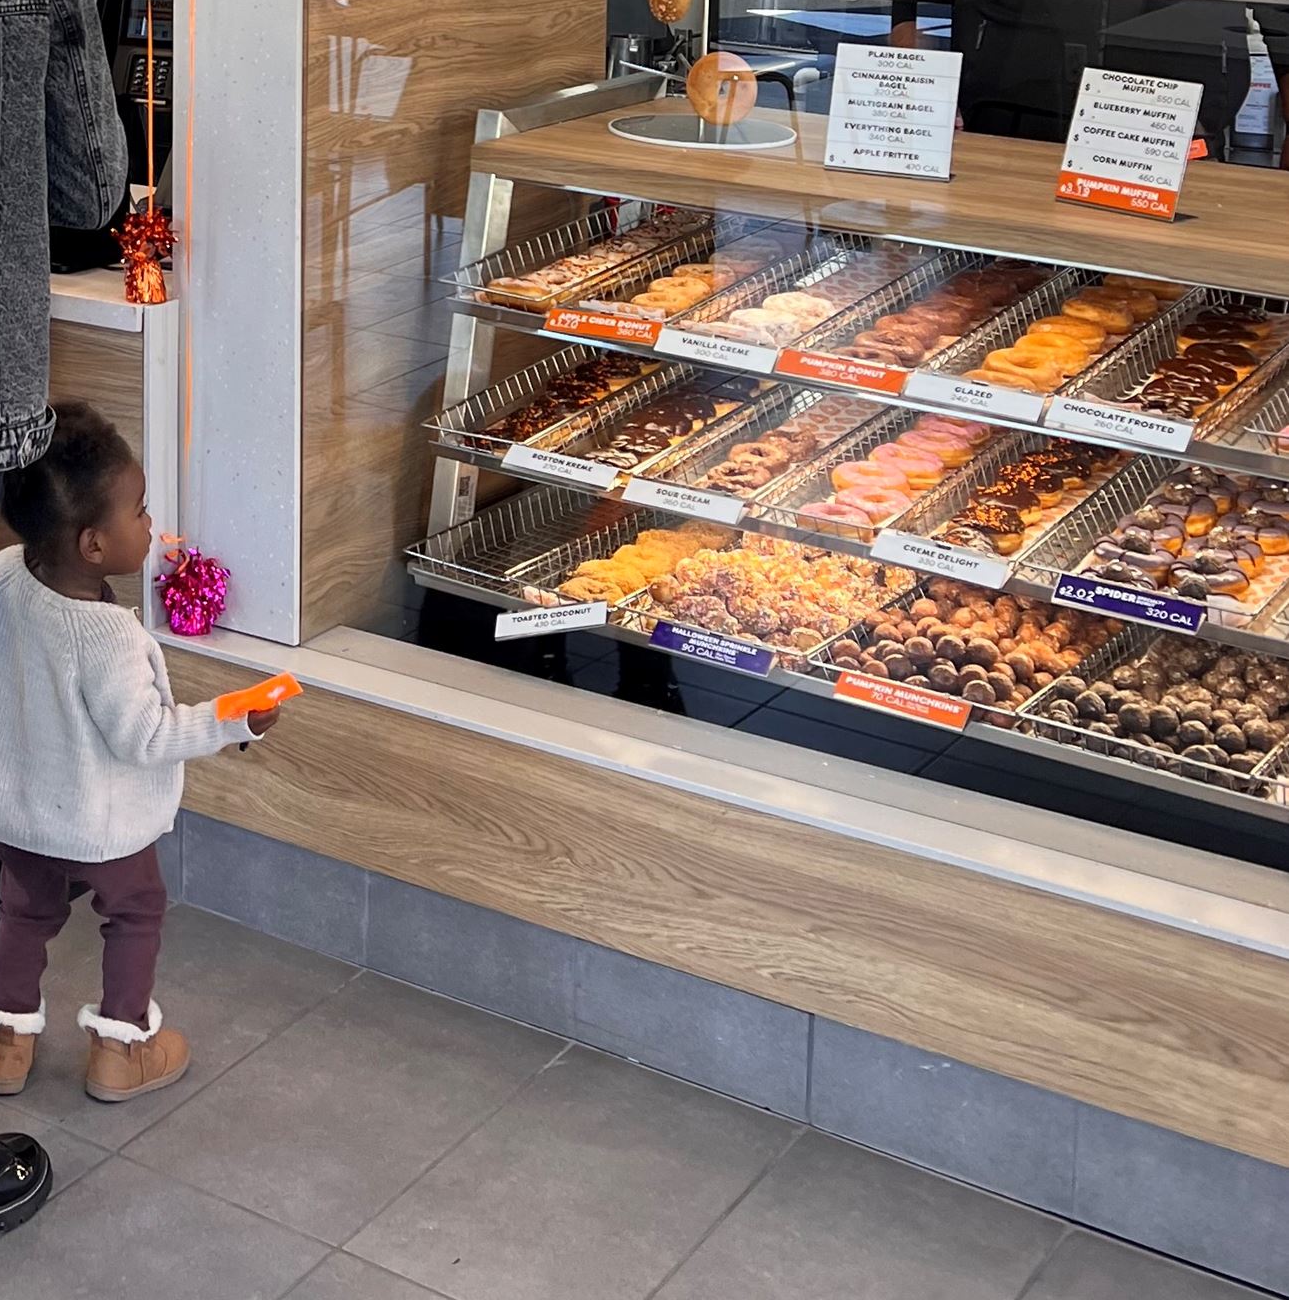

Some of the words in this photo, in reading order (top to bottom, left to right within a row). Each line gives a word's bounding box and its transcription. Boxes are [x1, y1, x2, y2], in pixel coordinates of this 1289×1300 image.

[868, 51, 895, 59] PLAIN
[852, 71, 902, 82] CINNAMON
[905, 76, 934, 84] RAISIN
[879, 81, 907, 89] BAGEL
[1102, 73, 1155, 86] CHOCOLATE
[1157, 81, 1179, 90] CHIP
[1122, 84, 1156, 95] MUFFIN
[848, 99, 903, 110] MULTIGRAIN
[906, 104, 934, 112] BAGEL
[1094, 102, 1142, 115] BLUEBERRY
[1143, 109, 1177, 121] MUFFIN
[844, 123, 901, 134] EVERYTHING
[904, 128, 933, 137] BAGEL
[1083, 126, 1115, 138] COFFEE
[1117, 132, 1140, 142] CAKE
[1142, 135, 1175, 147] MUFFIN
[853, 148, 881, 157] APPLE
[883, 150, 919, 160] FRITTER
[1093, 155, 1117, 165] CORN
[1119, 160, 1153, 171] MUFFIN
[1076, 178, 1120, 195] PUMPKIN
[1121, 187, 1159, 200] MUFFIN
[1130, 198, 1148, 208] 550
[1150, 202, 1170, 212] CAL
[560, 312, 587, 324] APPLE
[589, 316, 616, 327] CIDER
[617, 319, 653, 331] DONUT
[681, 337, 718, 350] VANILLA
[720, 343, 750, 356] CREME
[799, 356, 847, 371] PUMPKIN
[848, 364, 886, 379] DONUT
[954, 385, 993, 399] GLAZED
[1063, 403, 1126, 423] CHOCOLATE
[1128, 418, 1175, 434] FROSTED
[532, 452, 564, 466] BOSTON
[565, 459, 594, 472] KREME
[656, 487, 679, 499] SOUR
[681, 492, 711, 505] CREAM
[903, 544, 936, 558] CREME
[938, 553, 980, 569] DELIGHT
[1059, 585, 1095, 602] $2.02
[1095, 586, 1136, 603] SPIDER
[511, 613, 549, 623] TOASTED
[550, 607, 592, 619] COCONUT
[1145, 608, 1168, 619] 320
[1170, 613, 1193, 626] CAL
[672, 626, 720, 646] HALLOWEEN
[720, 638, 758, 656] SPRINKLE
[681, 643, 696, 654] 90
[696, 648, 715, 661] CAL
[846, 676, 893, 695] PUMPKIN
[872, 691, 883, 700] 70
[885, 696, 905, 706] CAL
